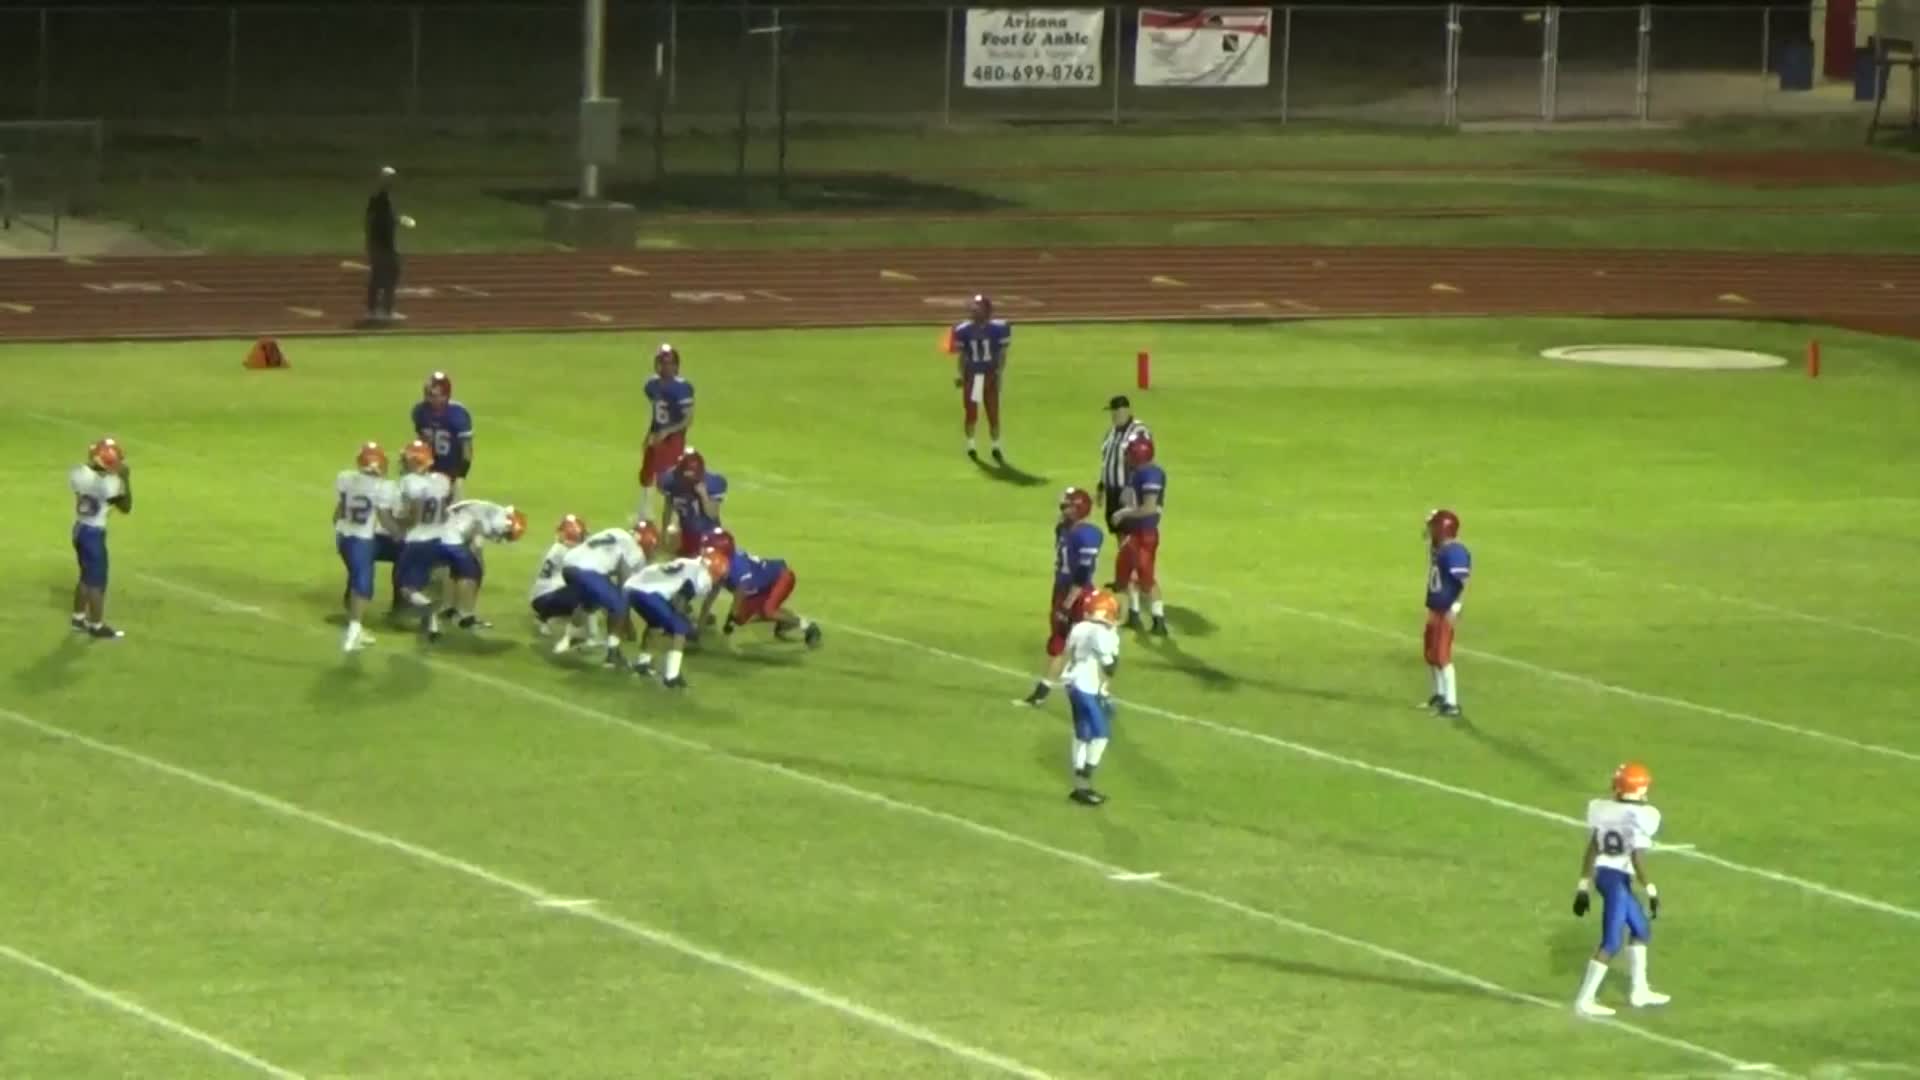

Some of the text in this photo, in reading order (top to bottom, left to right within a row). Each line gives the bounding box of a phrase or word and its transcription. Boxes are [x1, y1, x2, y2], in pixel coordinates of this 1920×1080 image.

[981, 32, 1089, 47] Foot & Ankle
[969, 338, 993, 362] 11
[340, 491, 373, 525] 12
